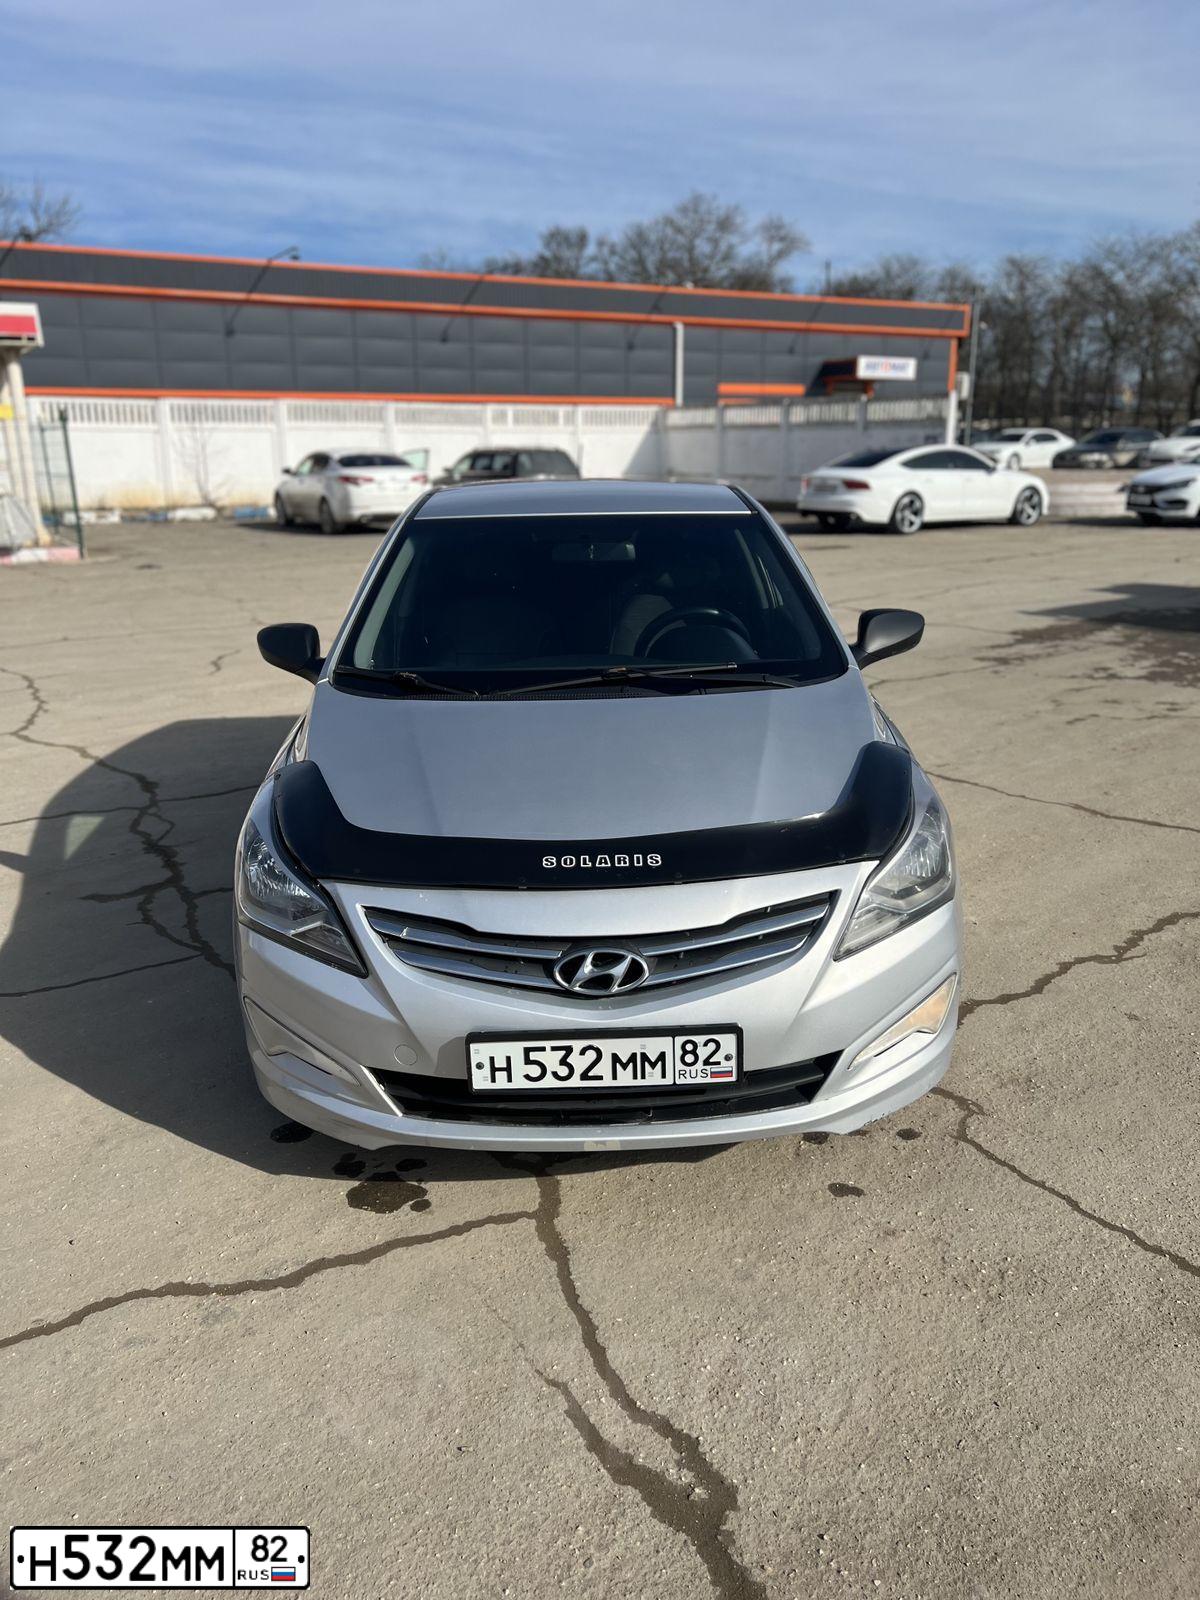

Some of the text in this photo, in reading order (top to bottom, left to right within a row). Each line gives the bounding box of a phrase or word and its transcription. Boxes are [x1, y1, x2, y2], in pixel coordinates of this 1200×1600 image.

[543, 854, 662, 868] SOLARIS
[680, 1038, 722, 1067] 82
[678, 1068, 709, 1080] RUS
